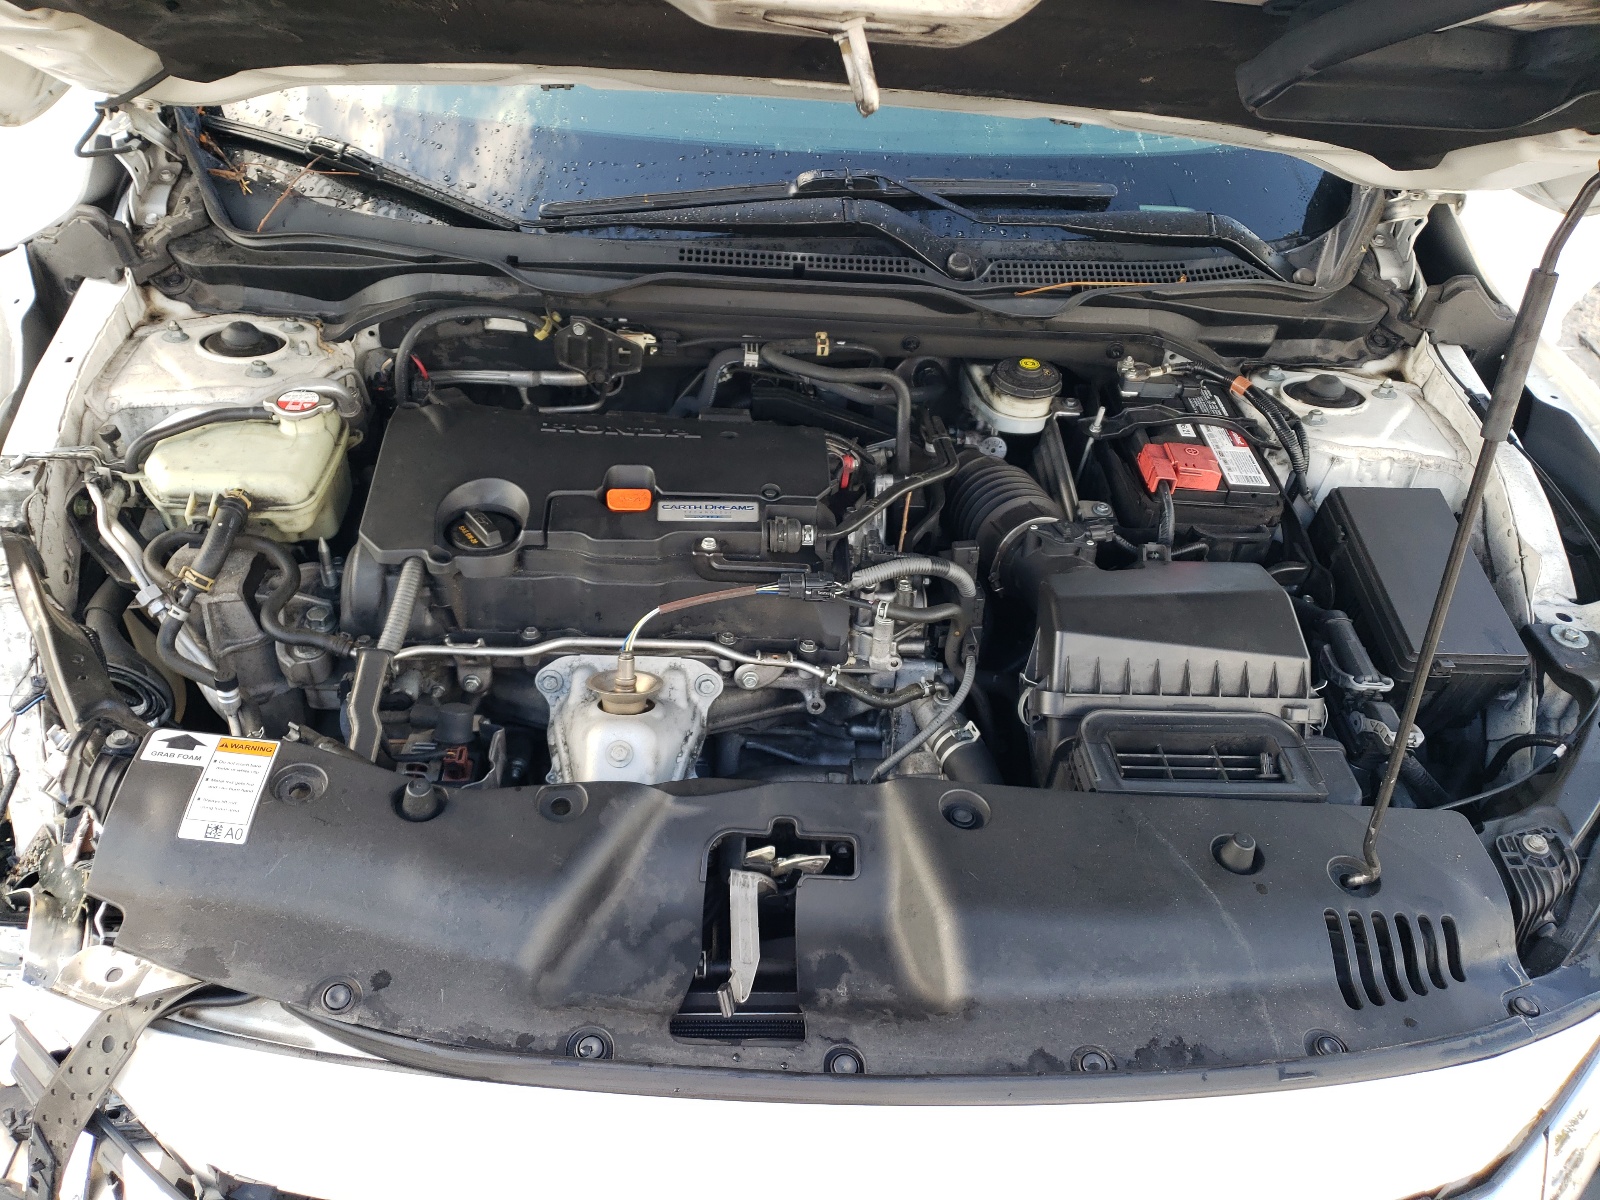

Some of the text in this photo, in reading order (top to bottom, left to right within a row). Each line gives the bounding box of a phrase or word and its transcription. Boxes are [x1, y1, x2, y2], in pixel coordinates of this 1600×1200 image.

[541, 422, 701, 438] HONDA
[230, 743, 273, 753] WARNING
[151, 750, 202, 762] GRAB FOAM
[224, 828, 243, 840] A0
